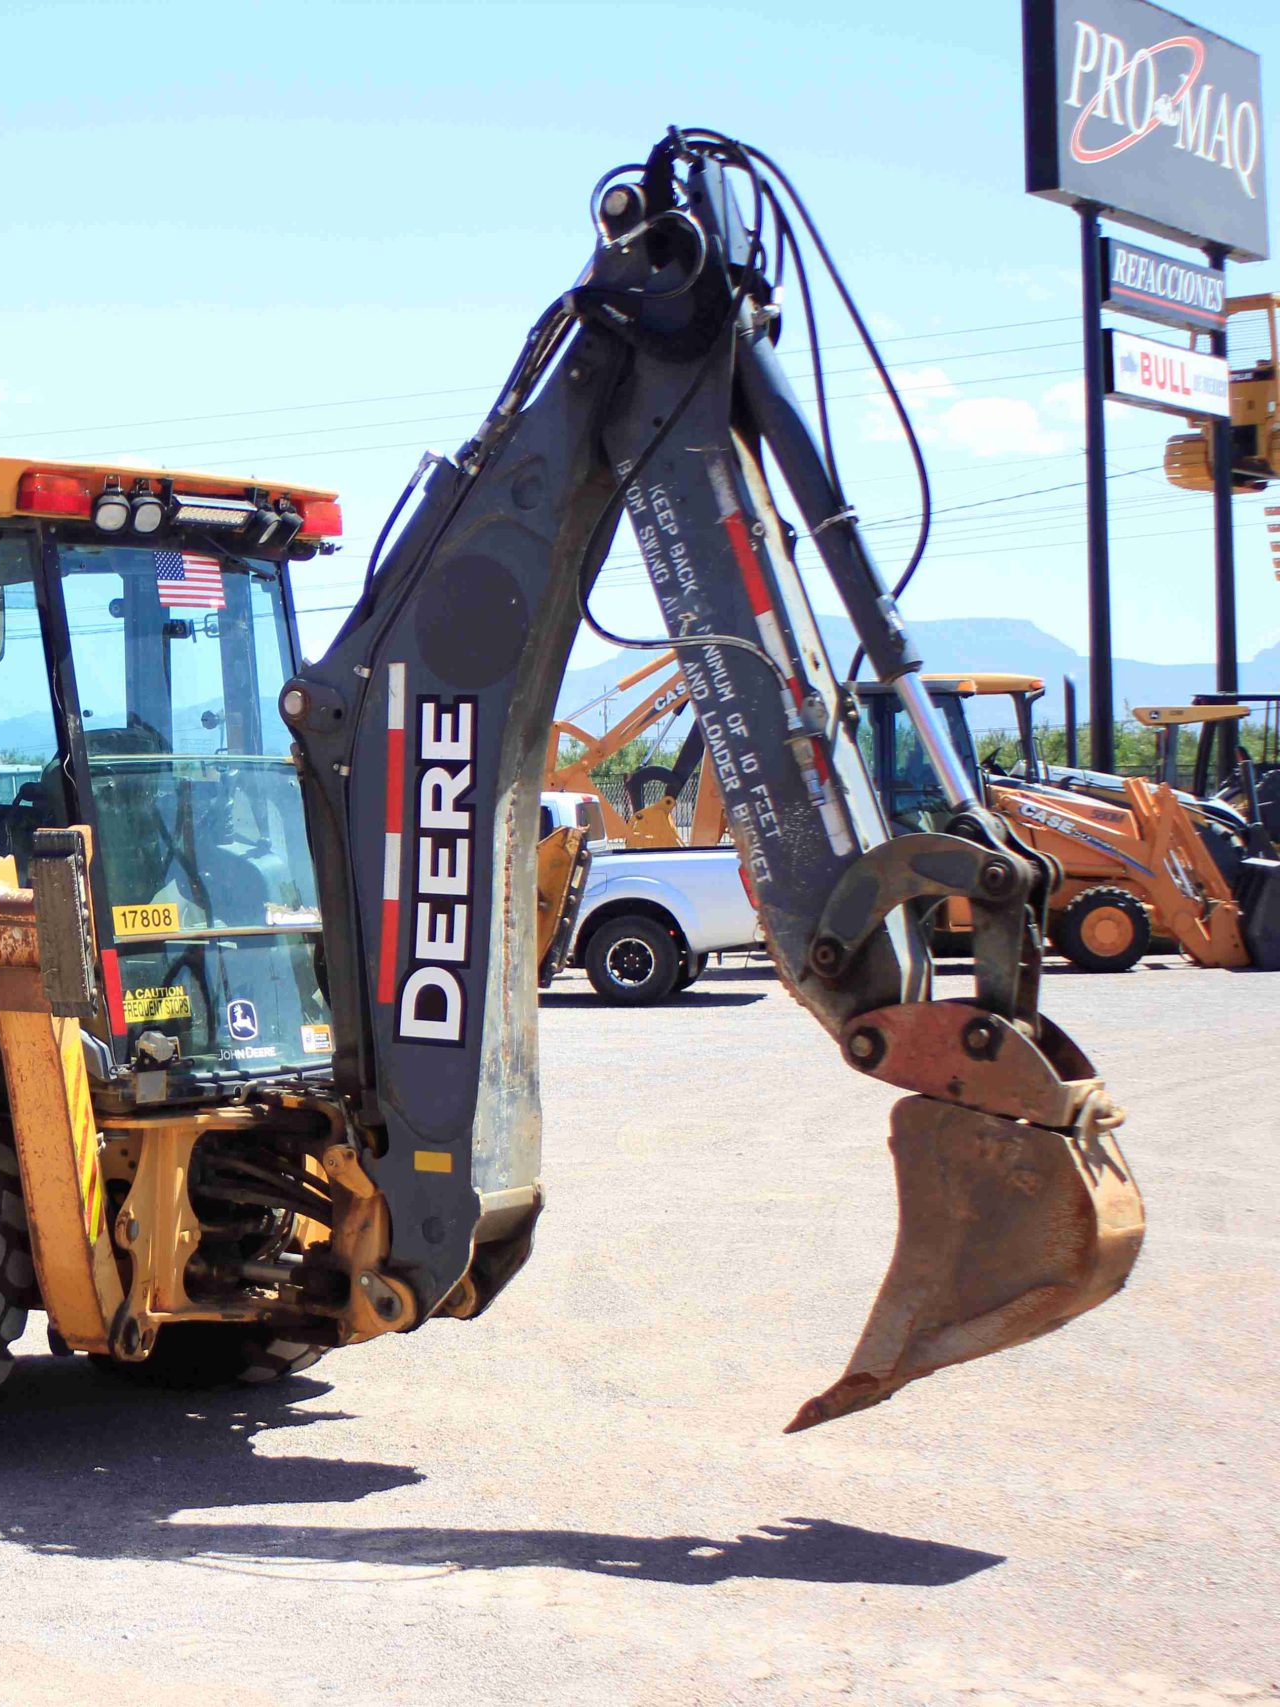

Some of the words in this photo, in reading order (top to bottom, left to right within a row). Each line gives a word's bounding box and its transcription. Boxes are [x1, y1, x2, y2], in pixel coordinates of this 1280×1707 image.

[1064, 21, 1157, 134] PRO
[1173, 73, 1259, 199] MAQ
[1112, 248, 1224, 312] REFACCIONES
[1140, 351, 1191, 396] BULL
[616, 459, 647, 515] BOM
[639, 525, 669, 584] SWING
[683, 662, 710, 701] AND
[701, 710, 741, 793] LOADER
[648, 483, 679, 536] KEEP
[669, 542, 699, 597] BACK
[697, 624, 735, 703] NIMUM
[726, 712, 749, 738] OF
[739, 752, 759, 774] 10
[750, 784, 782, 838] FEET
[654, 681, 687, 711] CAS
[1020, 803, 1075, 835] CASE
[399, 702, 472, 1041] DEERE
[121, 908, 173, 929] 17808
[122, 1000, 162, 1018] FREQUENT
[164, 998, 189, 1015] STOPS
[135, 985, 184, 999] CAUTION
[218, 1049, 245, 1061] JOHN
[245, 1046, 277, 1058] DEERE
